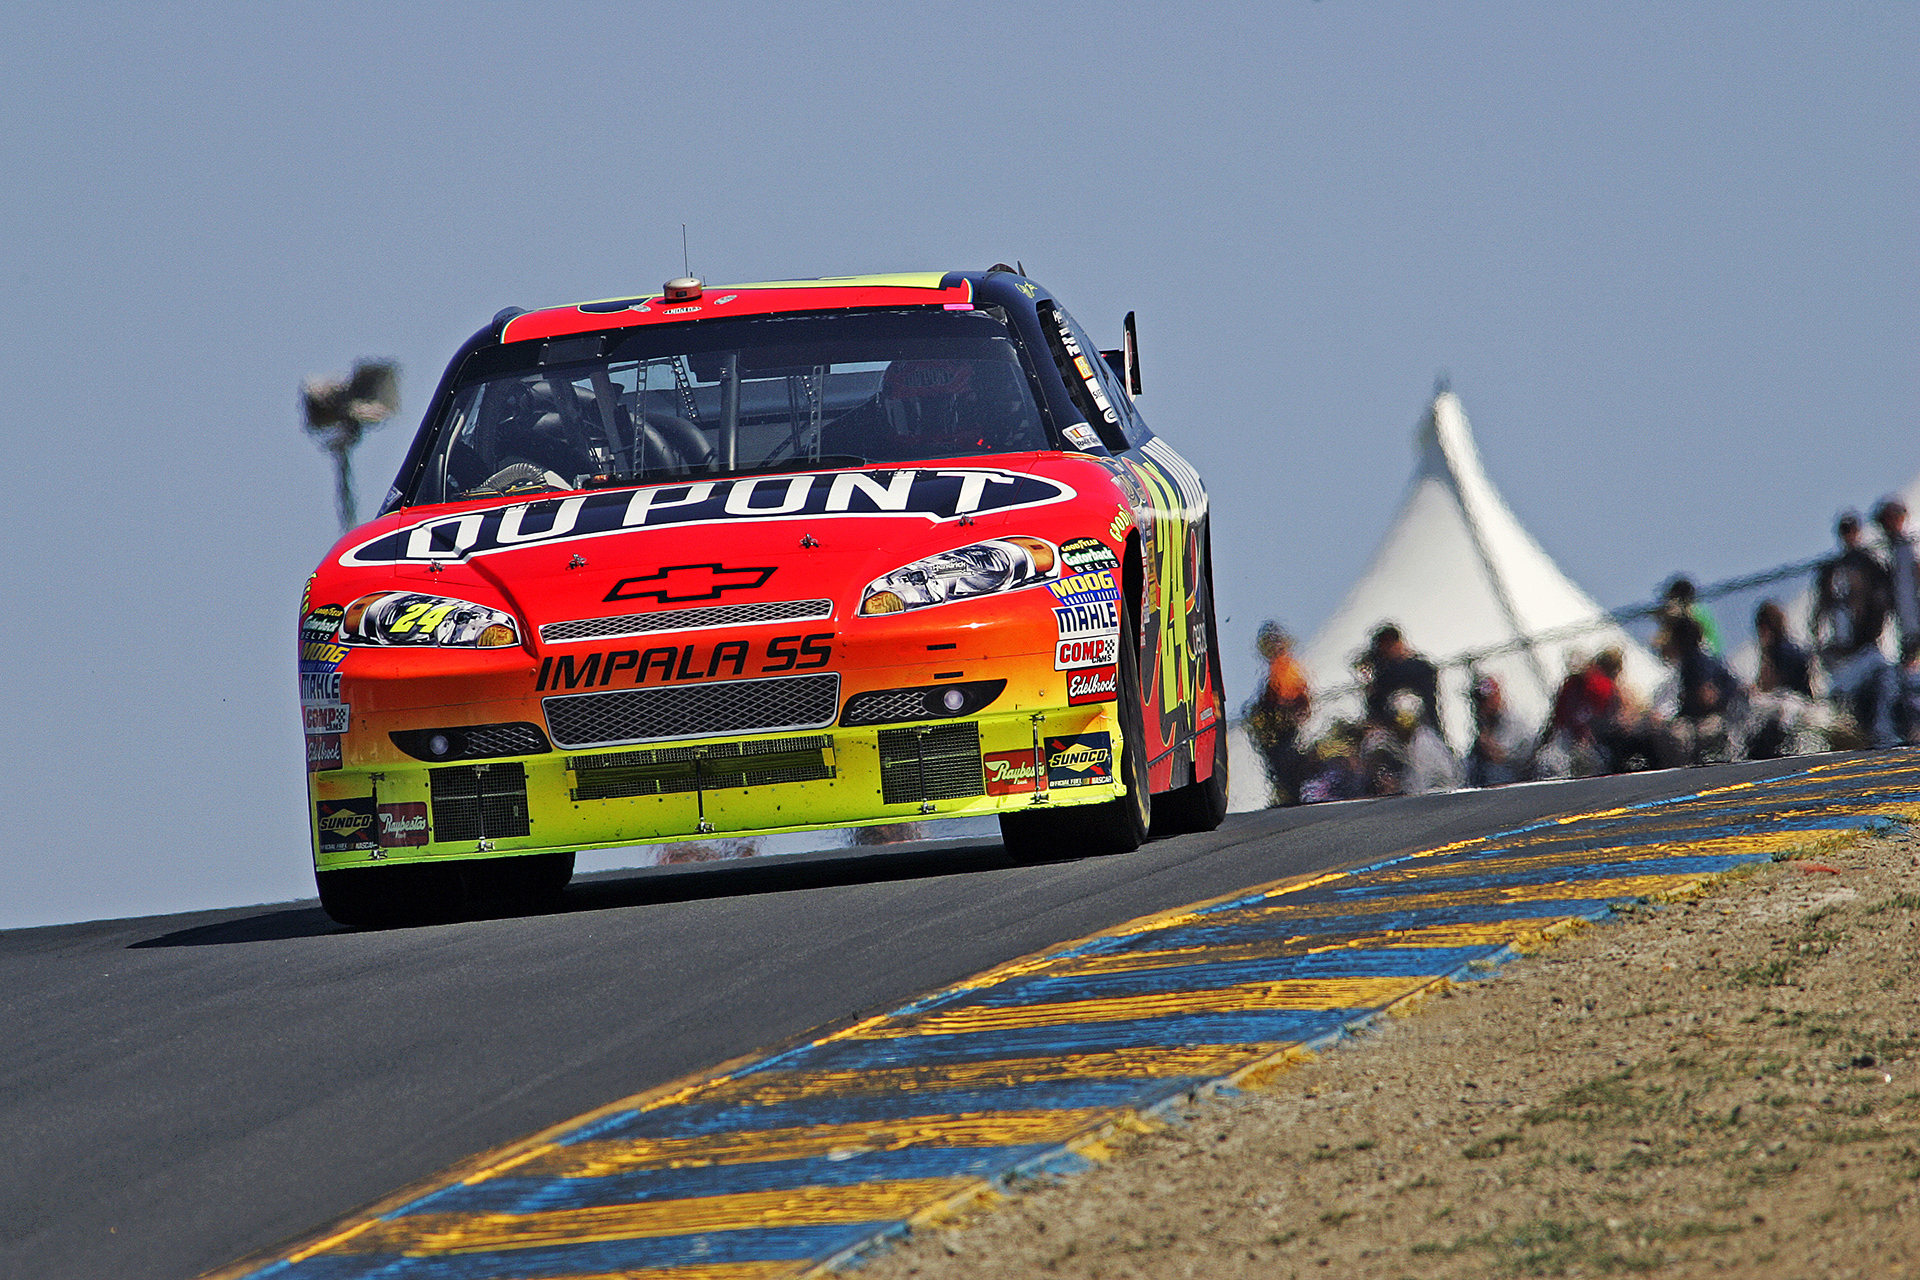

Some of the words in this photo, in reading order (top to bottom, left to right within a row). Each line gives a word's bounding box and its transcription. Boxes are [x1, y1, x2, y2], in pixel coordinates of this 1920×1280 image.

[1061, 547, 1116, 566] Gatorback
[1074, 560, 1118, 573] BELTS
[1049, 570, 1115, 598] MOOG
[389, 603, 459, 633] 24
[1055, 602, 1117, 633] MAHLE
[301, 631, 330, 641] BELTS
[302, 642, 351, 663] MOOG
[1060, 640, 1104, 663] COMP
[1092, 654, 1112, 664] CAMS
[535, 640, 749, 692] IMPALA
[761, 633, 835, 672] SS
[301, 673, 342, 699] MAHLE
[1069, 673, 1116, 697] Edelbrock
[306, 708, 336, 728] COMP
[308, 741, 340, 762] Edelbrock
[1051, 749, 1108, 766] SUNOCO
[320, 815, 371, 830] SUNOCO
[379, 813, 426, 838] Raybestos
